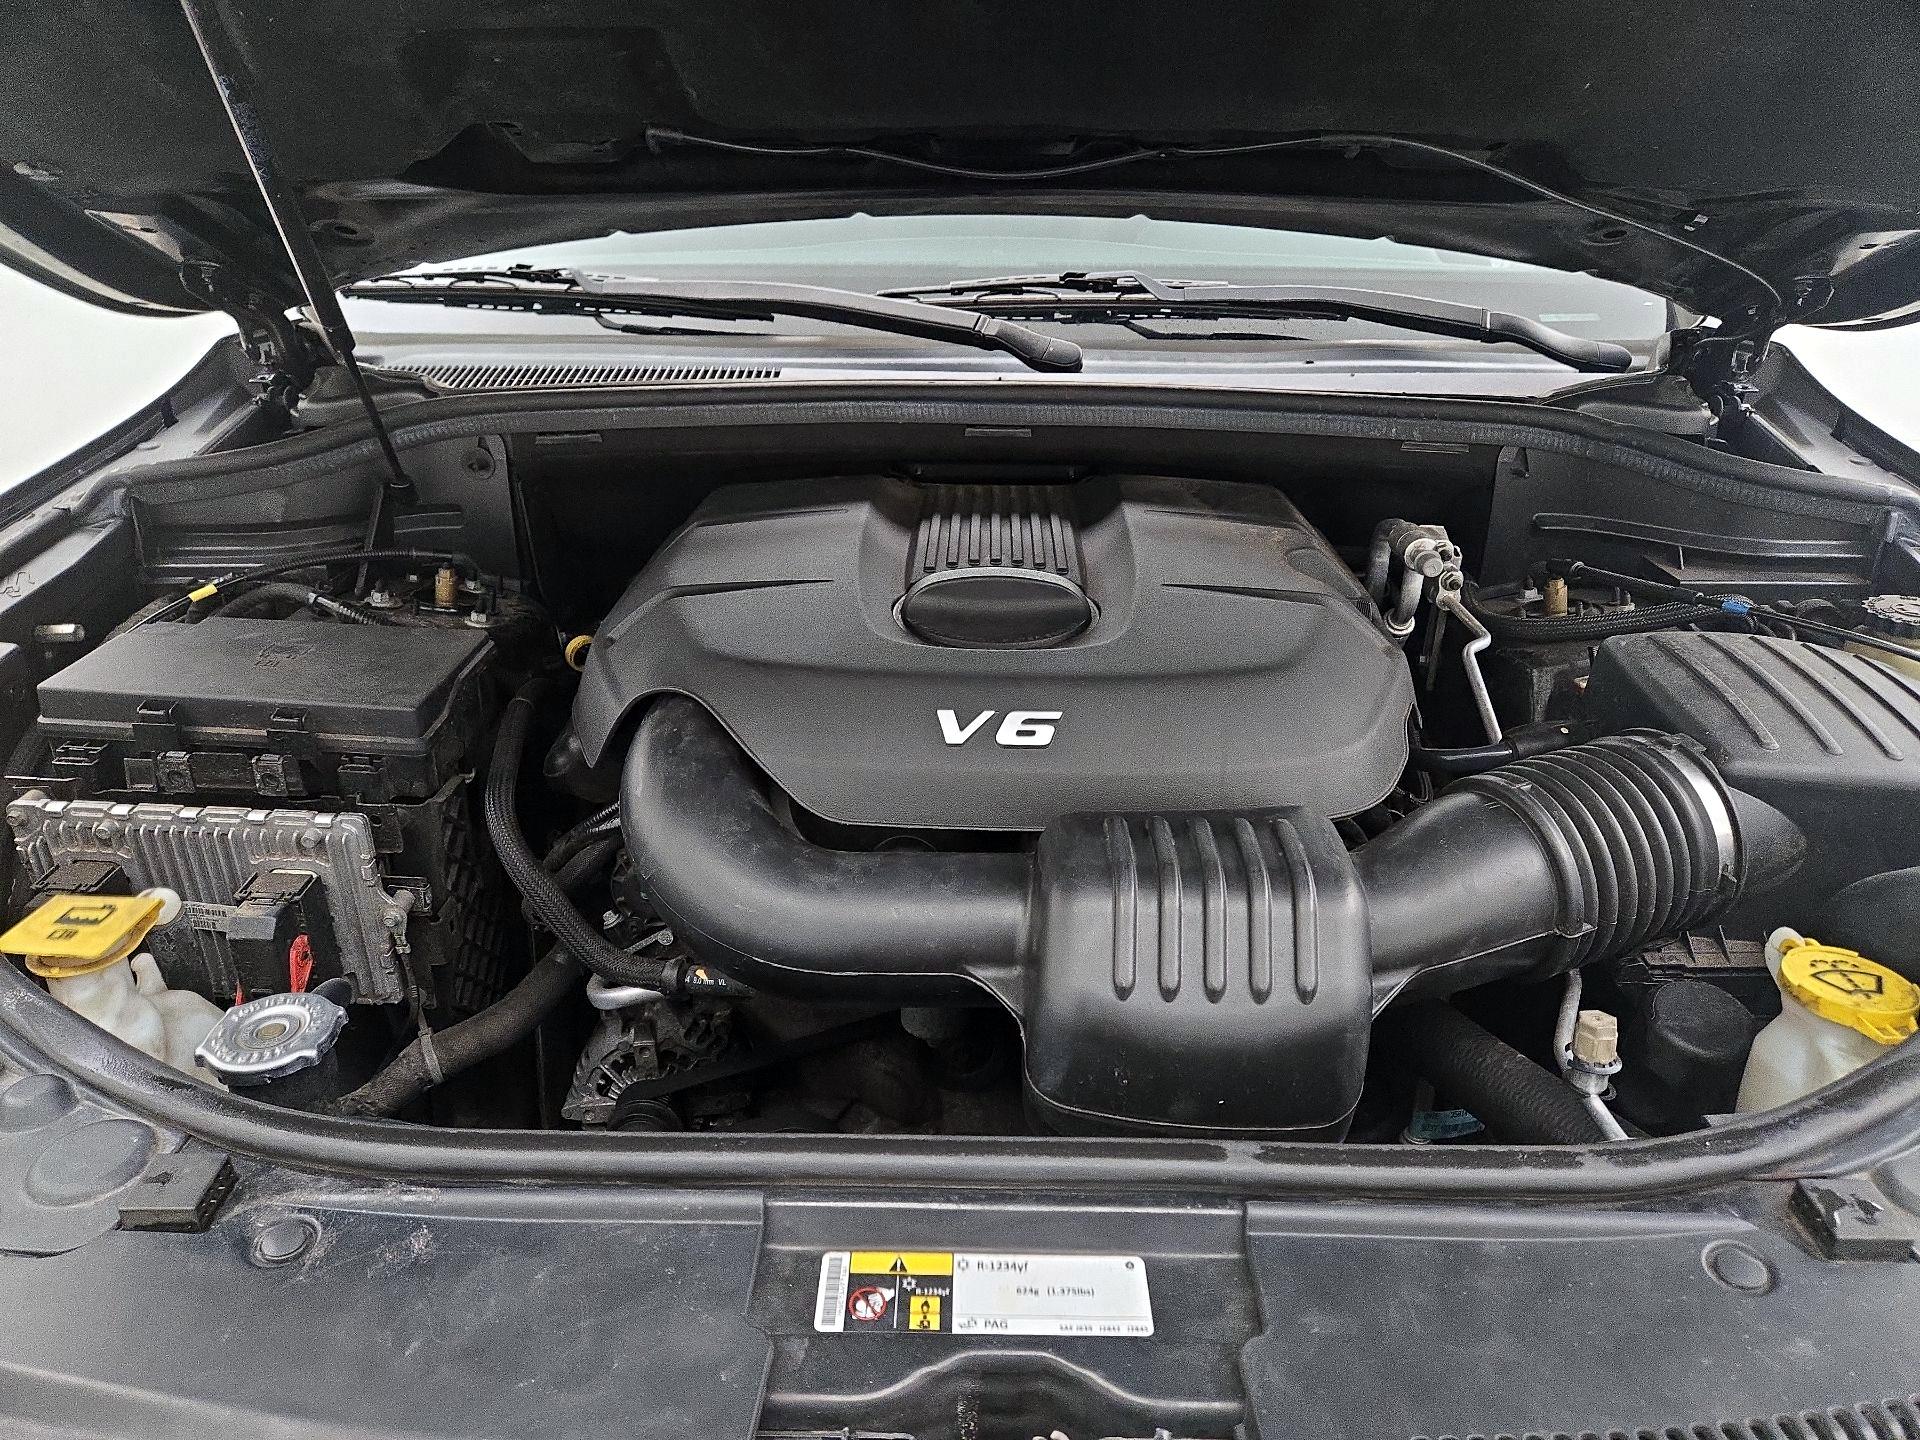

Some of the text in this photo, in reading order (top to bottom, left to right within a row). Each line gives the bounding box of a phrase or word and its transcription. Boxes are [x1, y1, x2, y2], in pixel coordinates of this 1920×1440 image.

[936, 709, 1063, 746] V6
[977, 1260, 1029, 1275] R-1234yf
[984, 1320, 1009, 1330] PAG
